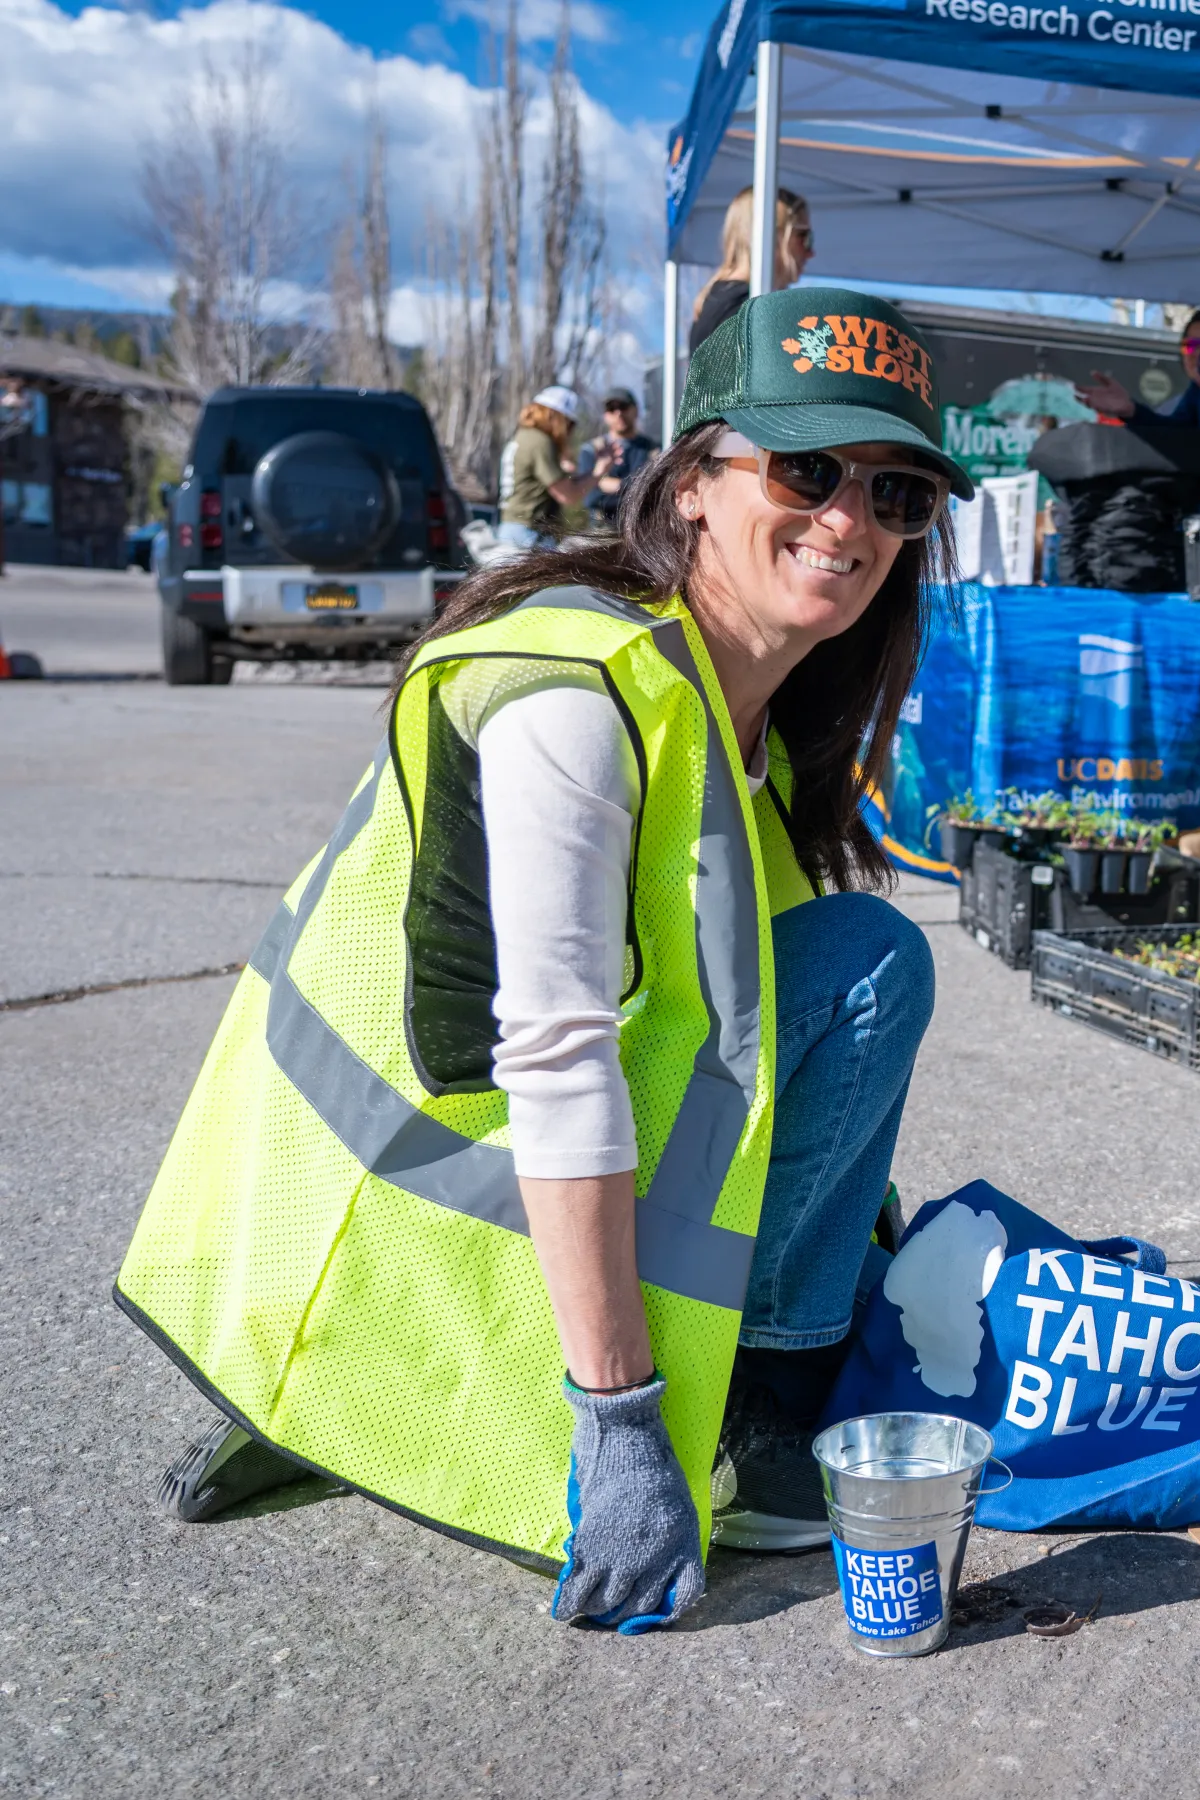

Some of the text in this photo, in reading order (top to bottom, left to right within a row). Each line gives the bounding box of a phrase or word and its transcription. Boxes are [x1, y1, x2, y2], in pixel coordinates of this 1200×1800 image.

[1087, 10, 1197, 52] Center
[823, 315, 933, 378] WEST
[825, 345, 934, 411] SLOPE
[845, 1549, 915, 1578] KEEP
[847, 1569, 937, 1600] TAHOE
[852, 1597, 922, 1623] BLUE
[856, 1622, 879, 1635] Save
[880, 1626, 907, 1636] Lake
[910, 1613, 940, 1632] Tahoe
